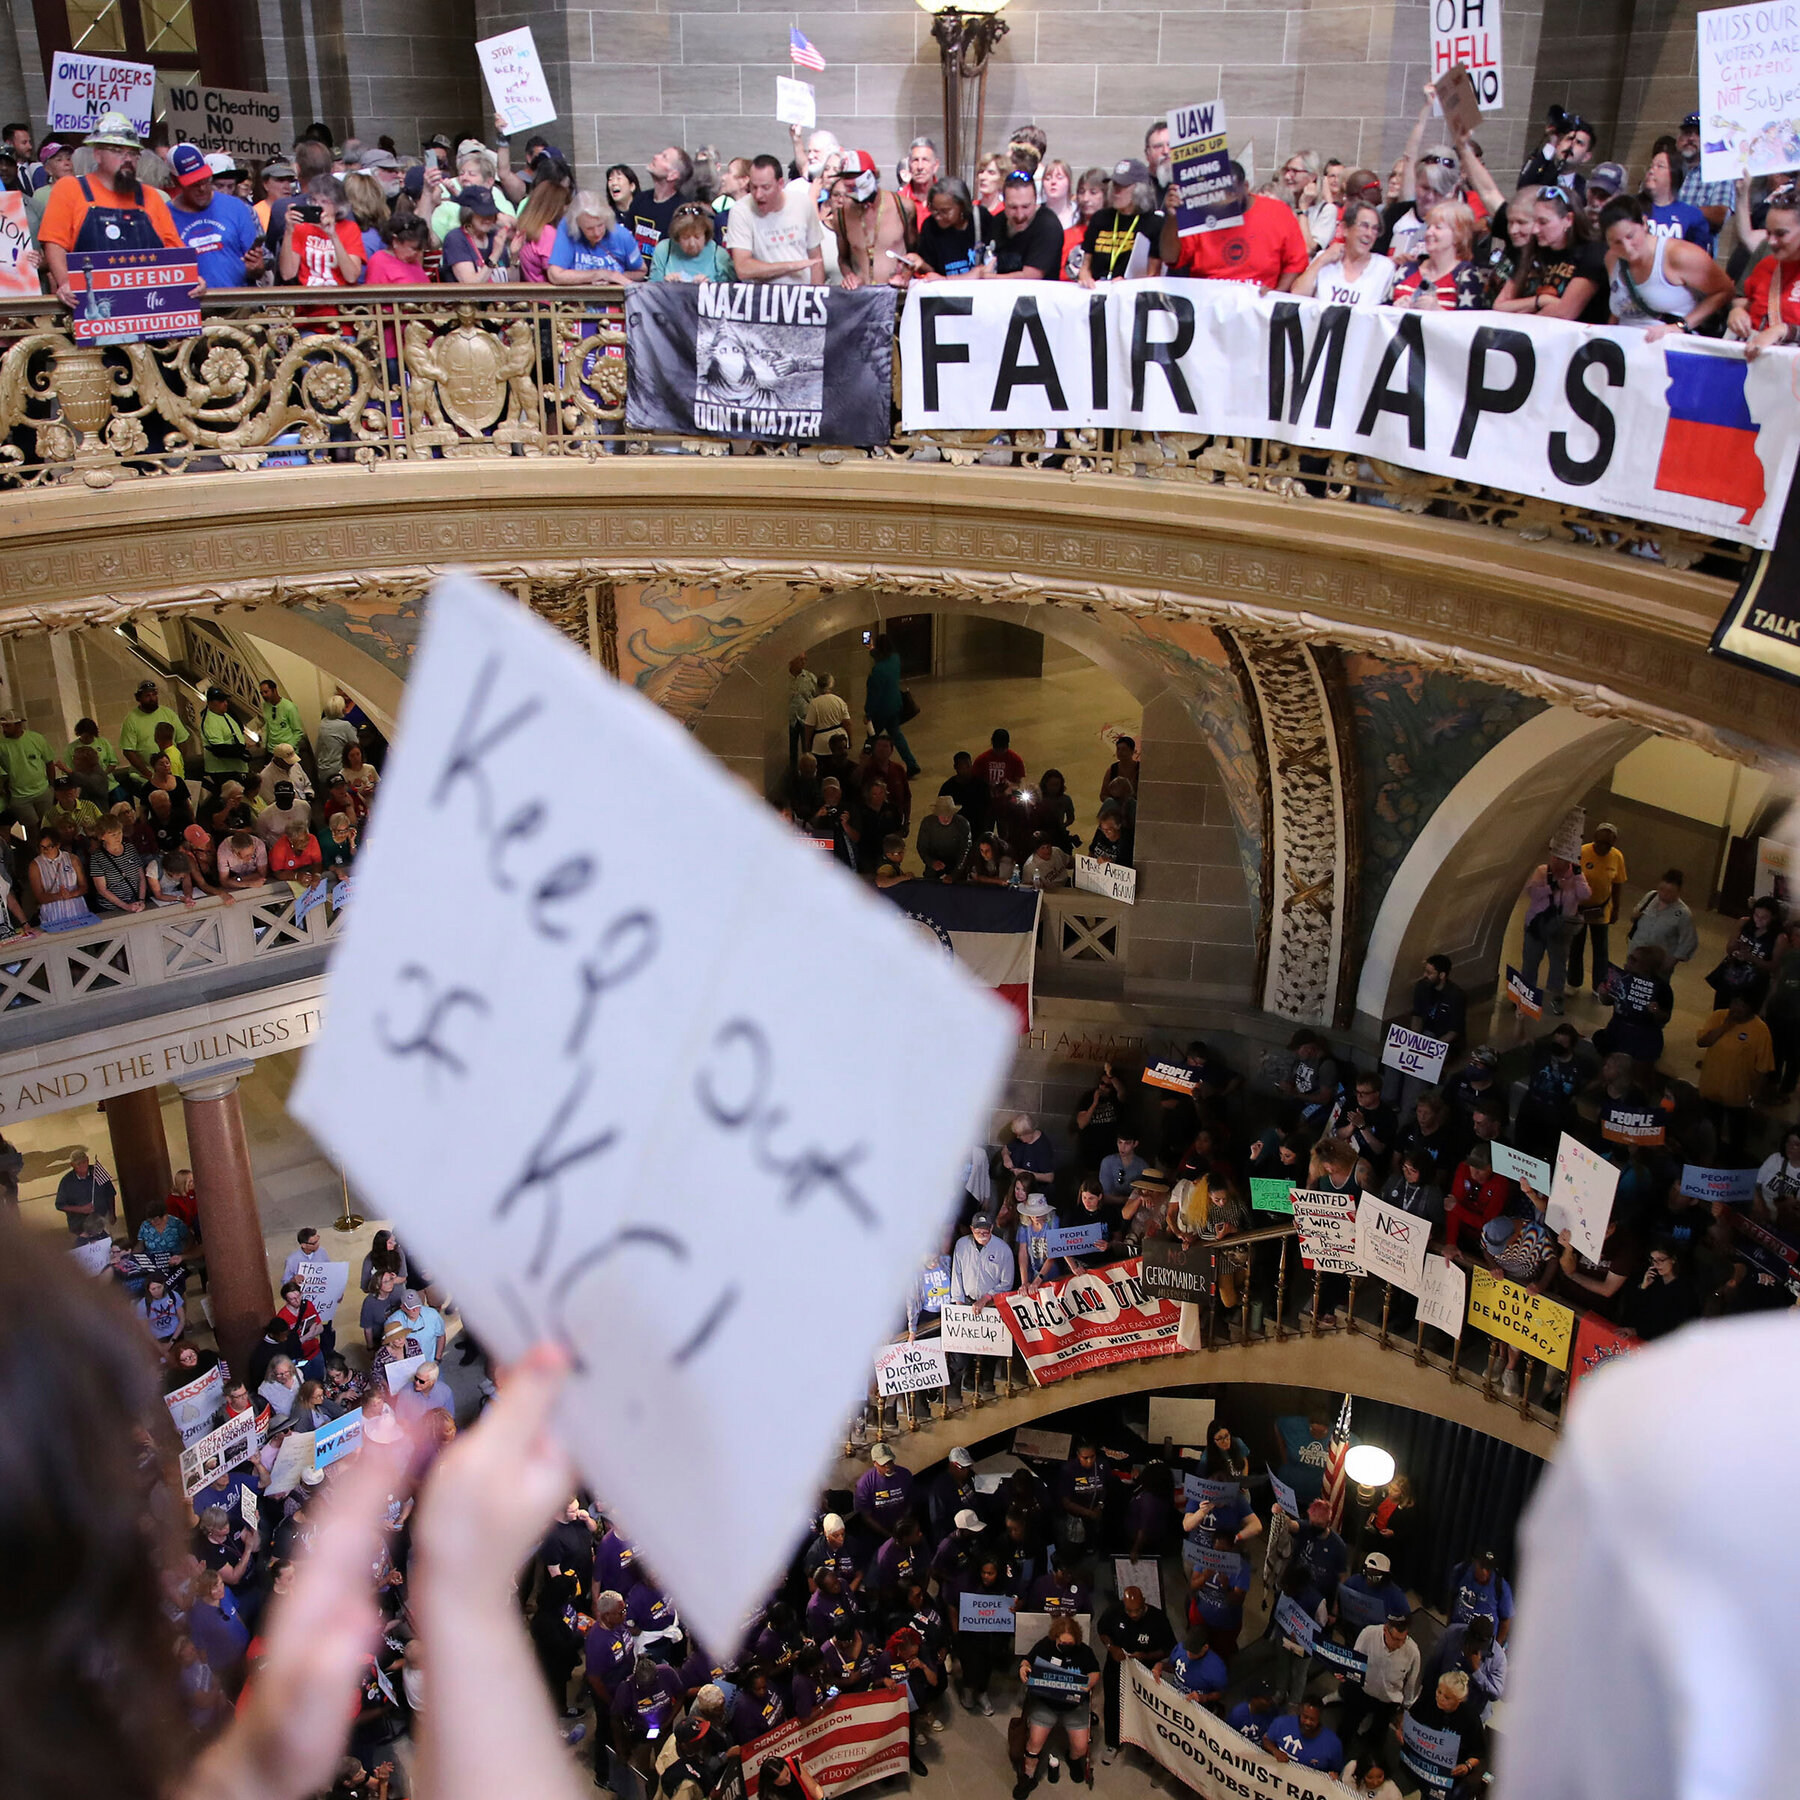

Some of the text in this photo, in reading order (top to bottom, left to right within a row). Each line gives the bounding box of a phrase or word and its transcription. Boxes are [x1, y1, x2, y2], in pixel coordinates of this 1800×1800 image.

[1772, 34, 1800, 51] ARE
[492, 46, 515, 60] STOP
[1436, 33, 1497, 73] HELL
[1714, 42, 1765, 65] VOTERS
[58, 63, 153, 87] ONLY LOSERS
[72, 82, 132, 102] CHEAT
[86, 100, 111, 115] NO
[171, 88, 279, 123] NO Cheating
[206, 114, 233, 134] NO
[1176, 105, 1214, 139] UAW
[1173, 138, 1224, 160] STAND UP
[1179, 161, 1220, 181] SAVING
[1185, 190, 1226, 210] DREAM
[109, 273, 186, 288] DEFEND
[145, 290, 165, 310] the
[698, 281, 830, 325] NAZI LIVES
[1331, 285, 1361, 304] YOU
[78, 313, 200, 336] CONSTITUTION
[919, 291, 1626, 487] FAIR MAPS
[694, 402, 823, 437] DON'T MATTER
[989, 768, 1005, 784] UP
[428, 652, 664, 1058] Keep
[1105, 863, 1132, 882] AMERICA
[1630, 982, 1654, 995] LINES
[1633, 976, 1655, 988] YOUR
[1629, 989, 1653, 1000] DON'T
[1632, 1003, 1644, 1012] US
[17, 1018, 290, 1111] AND THE FULLNESS
[1398, 1051, 1425, 1070] LOL
[1155, 1062, 1193, 1081] PEOPLE
[694, 1014, 884, 1234] Out
[1610, 1109, 1654, 1127] PEOPLE
[1604, 1121, 1662, 1137] OVER POLITICS!
[1508, 1152, 1538, 1169] RESPECT
[1511, 1165, 1537, 1180] VOTERS
[1701, 1173, 1740, 1184] PEOPLE
[1685, 1185, 1750, 1199] POLITICIANS
[1707, 1182, 1732, 1190] NOT
[1294, 1191, 1348, 1207] WANTED
[1309, 1217, 1341, 1231] WHO
[1060, 1230, 1089, 1240] PEOPLE
[1066, 1238, 1084, 1246] NOT
[1050, 1243, 1096, 1254] POLITICIAN
[1167, 1250, 1188, 1266] NO
[302, 1263, 324, 1276] the
[924, 1269, 948, 1285] FIRE
[1145, 1265, 1207, 1293] GERRYMANDER
[302, 1276, 328, 1286] ame
[1502, 1285, 1541, 1311] SAVE
[1012, 1287, 1107, 1331] RACIAL
[1498, 1299, 1533, 1323] OUR
[156, 1316, 172, 1328] NO
[946, 1324, 981, 1339] WAKE
[1472, 1300, 1557, 1356] DEMOCRACY
[1546, 1319, 1566, 1341] ALL
[1058, 1337, 1075, 1348] WE
[1075, 1330, 1102, 1342] WON'T
[1103, 1323, 1128, 1336] FIGHT
[1129, 1319, 1152, 1330] EACH
[1056, 1332, 1143, 1362] BLACK WHITE
[875, 1351, 897, 1372] SHOW
[896, 1343, 909, 1355] ME
[904, 1351, 922, 1365] NO
[1040, 1345, 1149, 1379] WE FIGHT WAGE SLAVERY
[885, 1358, 938, 1380] DICTATOR
[166, 1368, 220, 1408] MISSING
[885, 1372, 944, 1395] MISSOURI
[316, 1426, 361, 1457] MY ASS
[187, 1451, 249, 1496] DOWN WITH THEM
[1197, 1481, 1226, 1491] PEOPLE
[1202, 1489, 1221, 1497] NOT
[1196, 1548, 1226, 1561] PEOPLE
[1203, 1555, 1222, 1564] NOT
[973, 1601, 1003, 1610] PEOPLE
[979, 1609, 997, 1617] NOT
[961, 1616, 1012, 1627] POLITICIANS
[1287, 1603, 1311, 1631] PEOPLE
[1290, 1615, 1305, 1630] NOT
[1276, 1610, 1315, 1650] POLITICIANS
[1315, 1645, 1363, 1670] DEMOCRACY
[1322, 1640, 1354, 1658] DEFEND
[1033, 1679, 1083, 1691] DEMOCRACY
[1042, 1671, 1075, 1684] DEFEND
[752, 1720, 801, 1751] DEMOCRA
[756, 1714, 853, 1768] ECONOMIC FREEDOM
[1131, 1677, 1284, 1790] UNITED AGAINST
[1411, 1725, 1446, 1747] PEOPLE
[1403, 1732, 1455, 1766] POLITICIANS
[1416, 1736, 1437, 1751] NOT
[821, 1747, 868, 1767] TOGETHER
[1155, 1722, 1251, 1799] GOOD JOBS
[829, 1770, 842, 1780] DO
[843, 1766, 858, 1778] ON
[1403, 1756, 1450, 1789] DEMOCRACY
